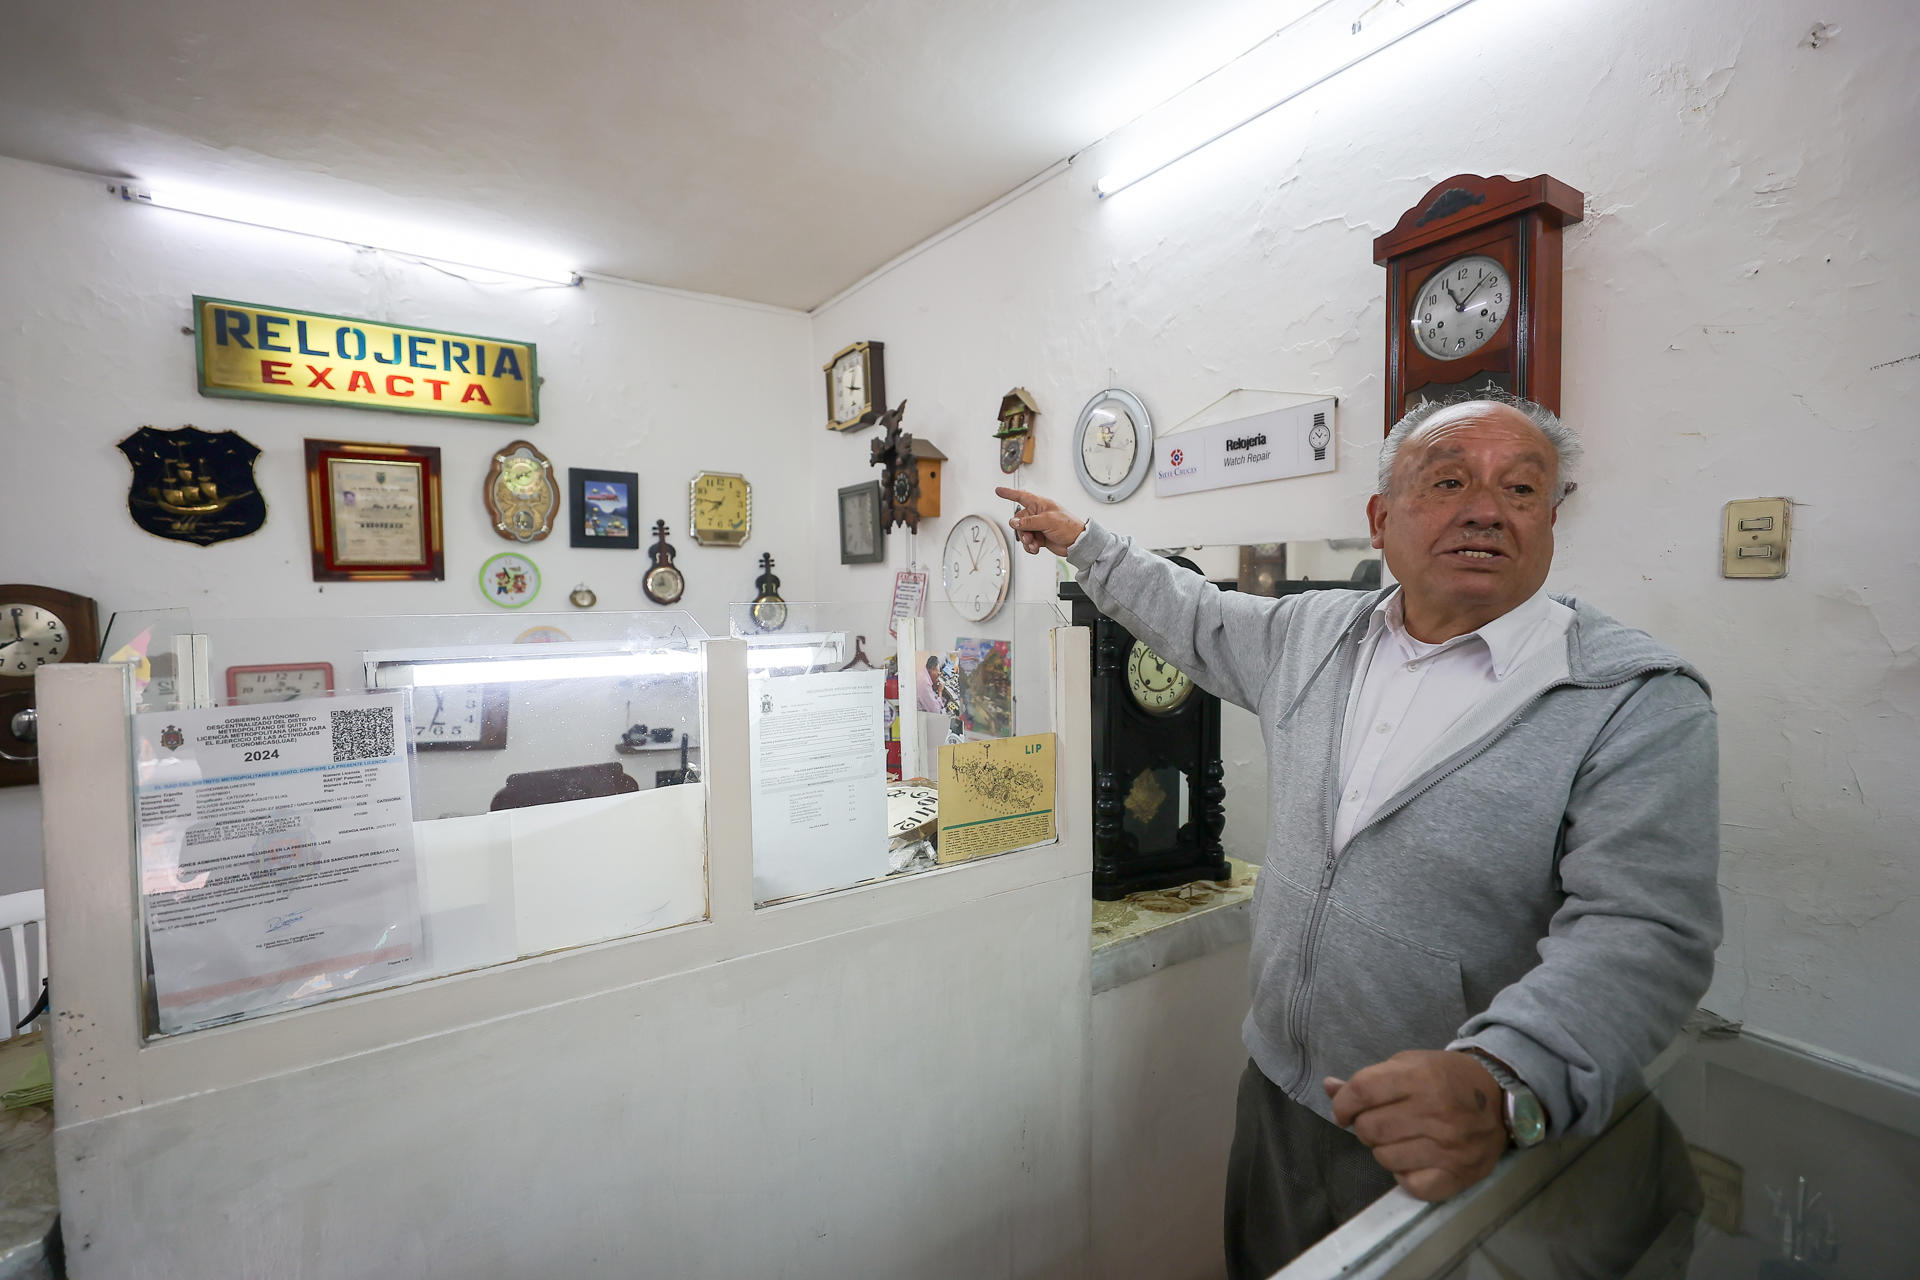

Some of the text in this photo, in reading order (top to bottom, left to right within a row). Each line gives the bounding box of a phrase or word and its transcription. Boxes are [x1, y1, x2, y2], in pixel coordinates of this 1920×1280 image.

[1458, 268, 1468, 280] 12
[1479, 268, 1482, 278] 1
[1441, 278, 1449, 290] 11
[1490, 277, 1498, 288] 2
[1429, 295, 1436, 306] 10
[1495, 293, 1502, 304] 3
[1425, 313, 1432, 323] 9
[1489, 312, 1497, 322] 4
[1428, 328, 1436, 339] 8
[1475, 329, 1483, 339] 5
[214, 308, 524, 381] RELOJERIA
[1441, 338, 1448, 348] 7
[260, 359, 492, 406] EXACTA
[1224, 451, 1271, 467] Watch Repair
[971, 526, 980, 543] 12
[954, 562, 959, 579] 9
[996, 558, 1002, 576] 3
[974, 594, 980, 612] 6
[1130, 664, 1136, 674] 9
[1134, 680, 1139, 690] 8
[207, 721, 272, 730] DESCENTRALIZADO
[218, 725, 275, 734] METROPOLITANO
[414, 726, 426, 736] 7
[432, 724, 444, 736] 6
[452, 726, 461, 735] 5
[231, 730, 286, 738] METROPOLITANA
[278, 731, 320, 739] ACTIVIDADES
[1025, 744, 1042, 754] LIP
[244, 749, 280, 762] 2024
